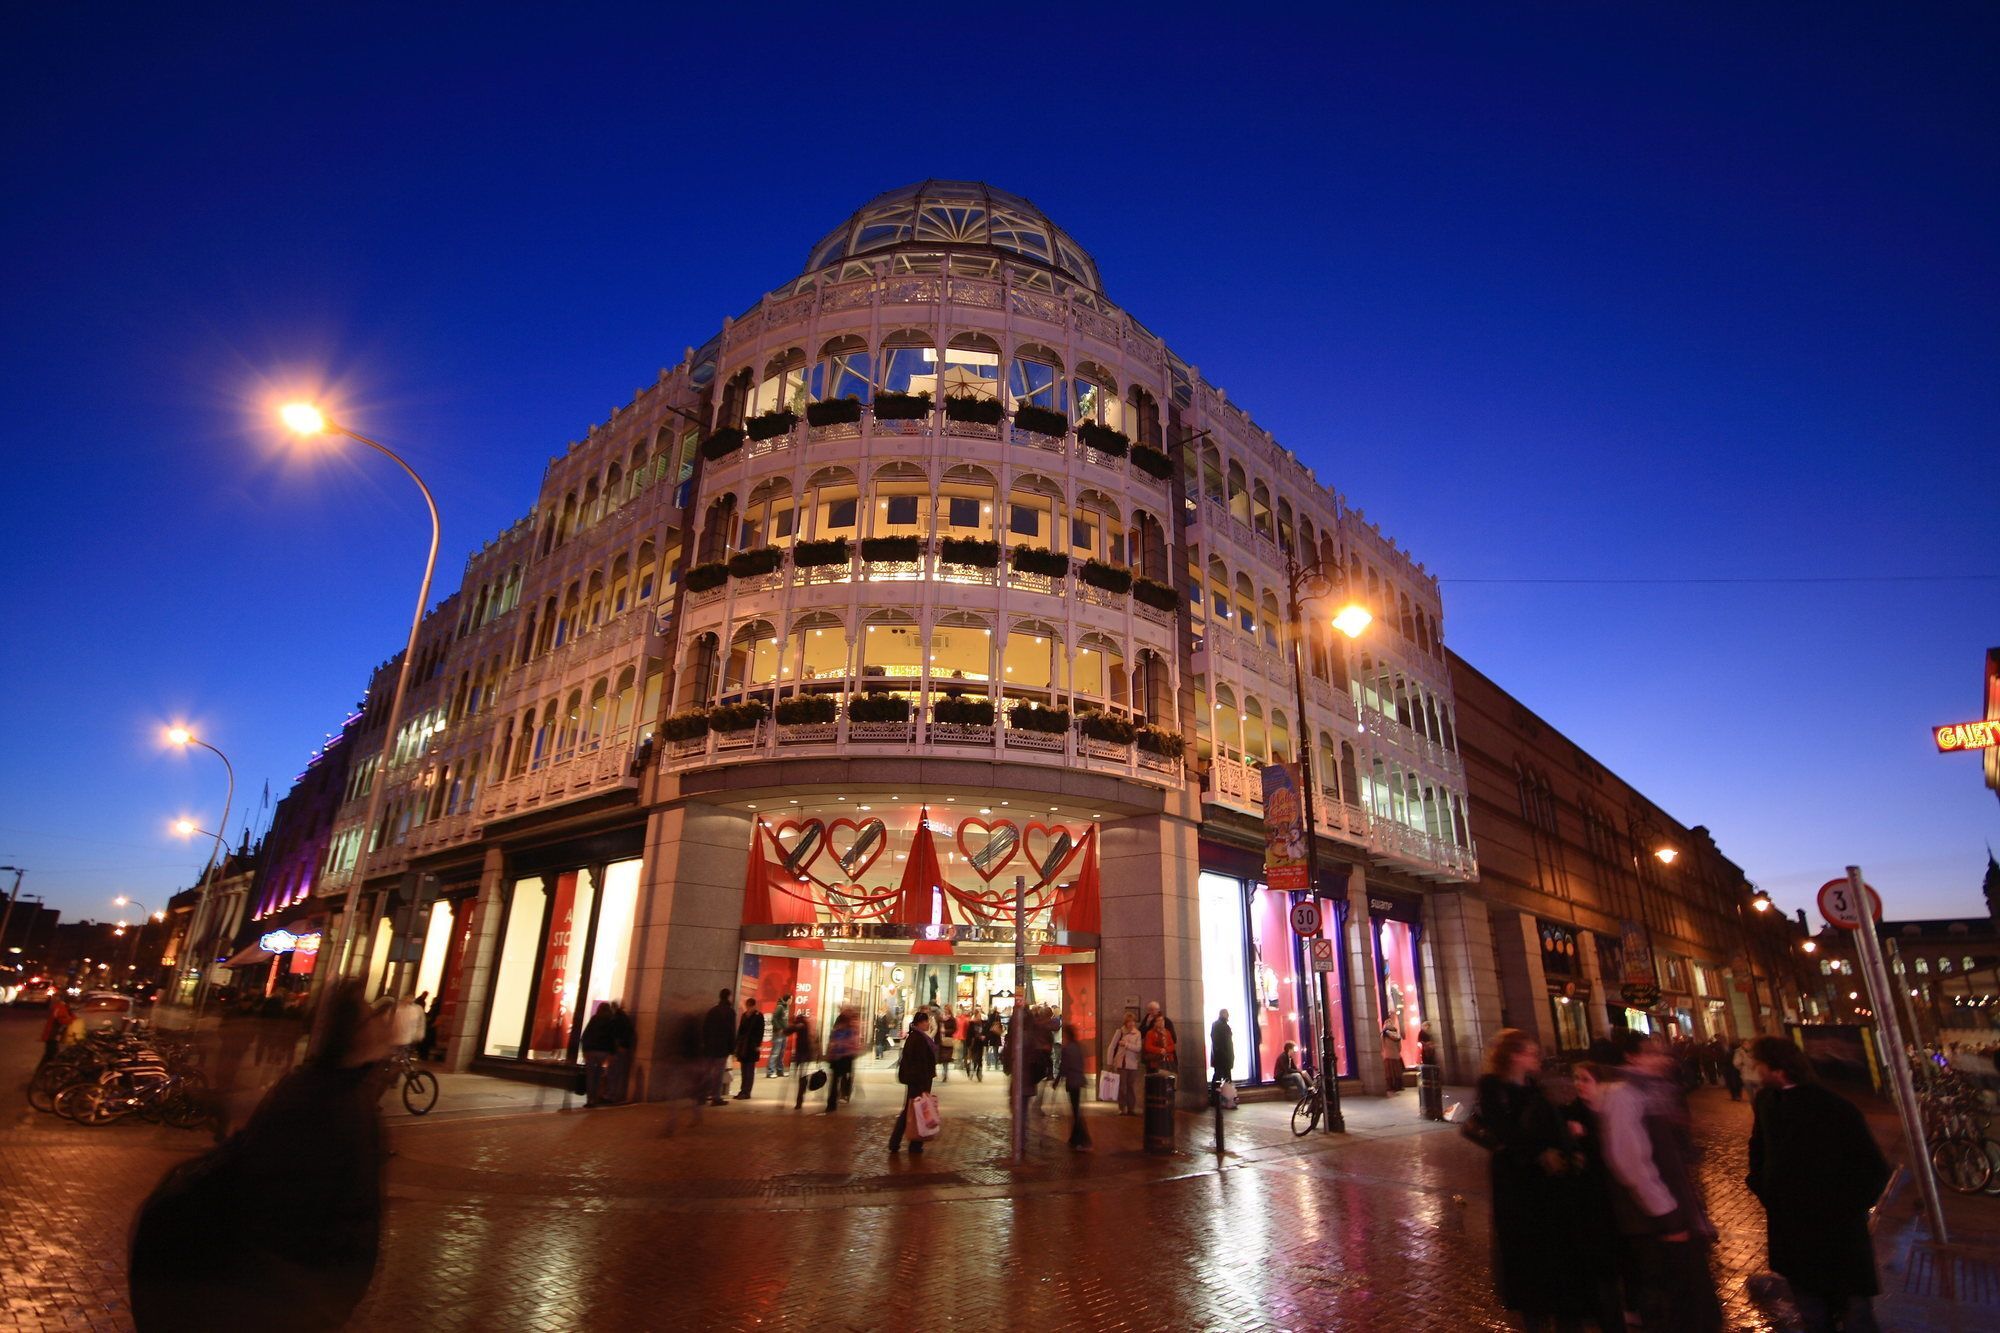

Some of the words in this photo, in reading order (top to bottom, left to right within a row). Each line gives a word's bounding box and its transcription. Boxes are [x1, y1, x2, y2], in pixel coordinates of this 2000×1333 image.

[1833, 890, 1855, 912] 3
[1297, 909, 1314, 925] 30
[795, 995, 809, 1005] OF
[794, 1008, 811, 1017] ALE
